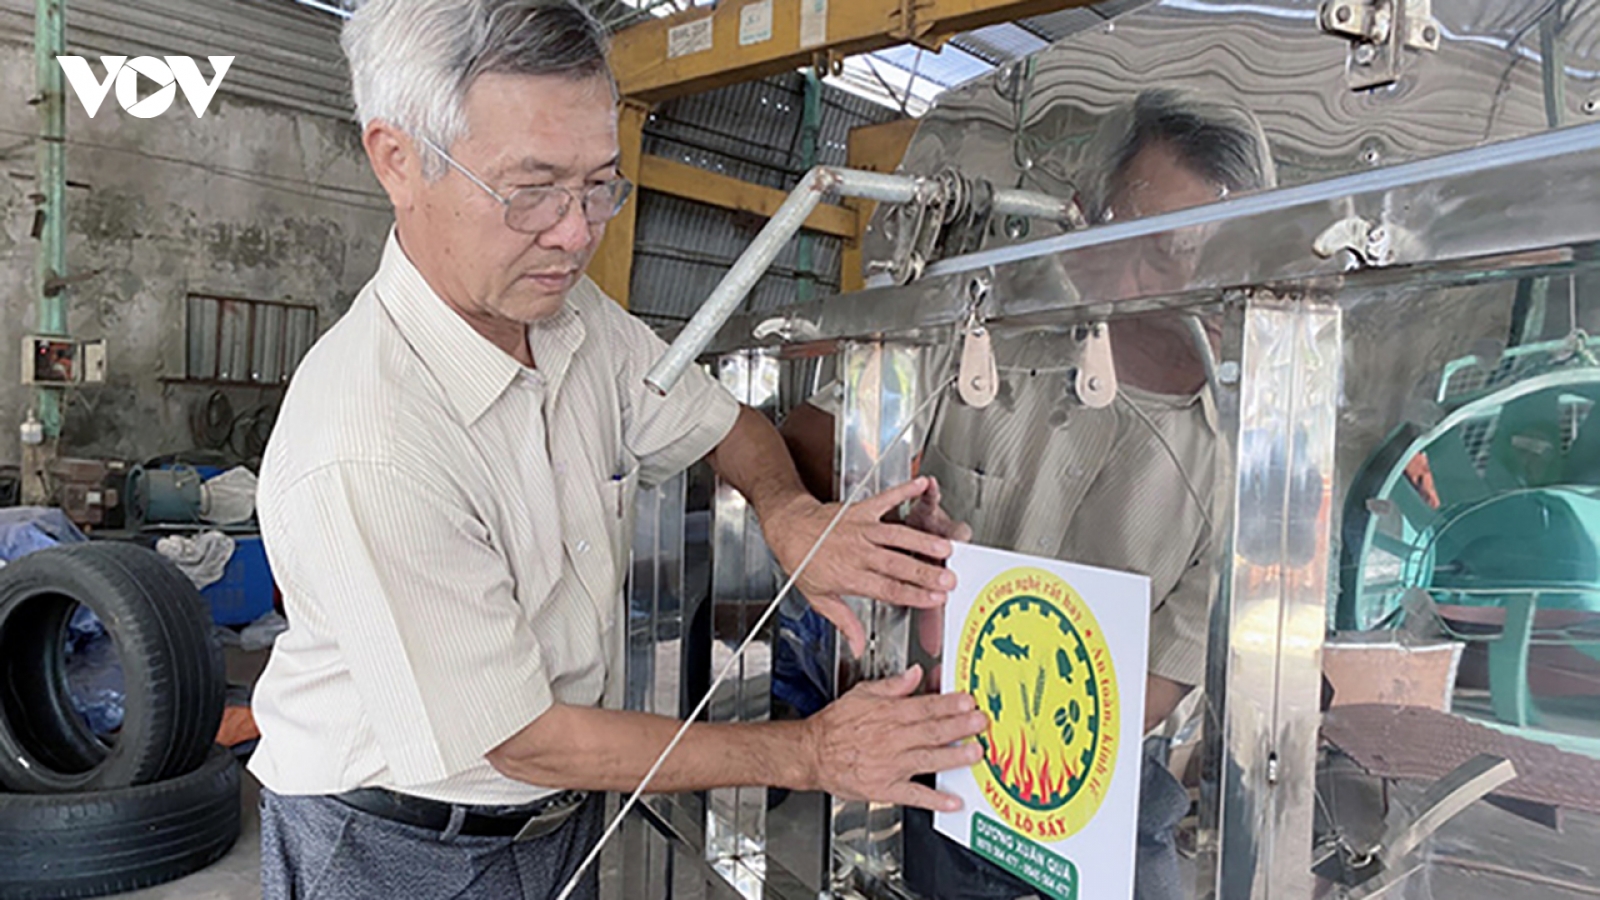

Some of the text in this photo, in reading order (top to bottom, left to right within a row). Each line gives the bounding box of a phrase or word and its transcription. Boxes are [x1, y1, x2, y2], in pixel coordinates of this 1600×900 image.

[1091, 648, 1106, 674] An
[1096, 734, 1114, 775] kinh
[984, 780, 1011, 821] VUA
[1038, 812, 1067, 838] SẤY
